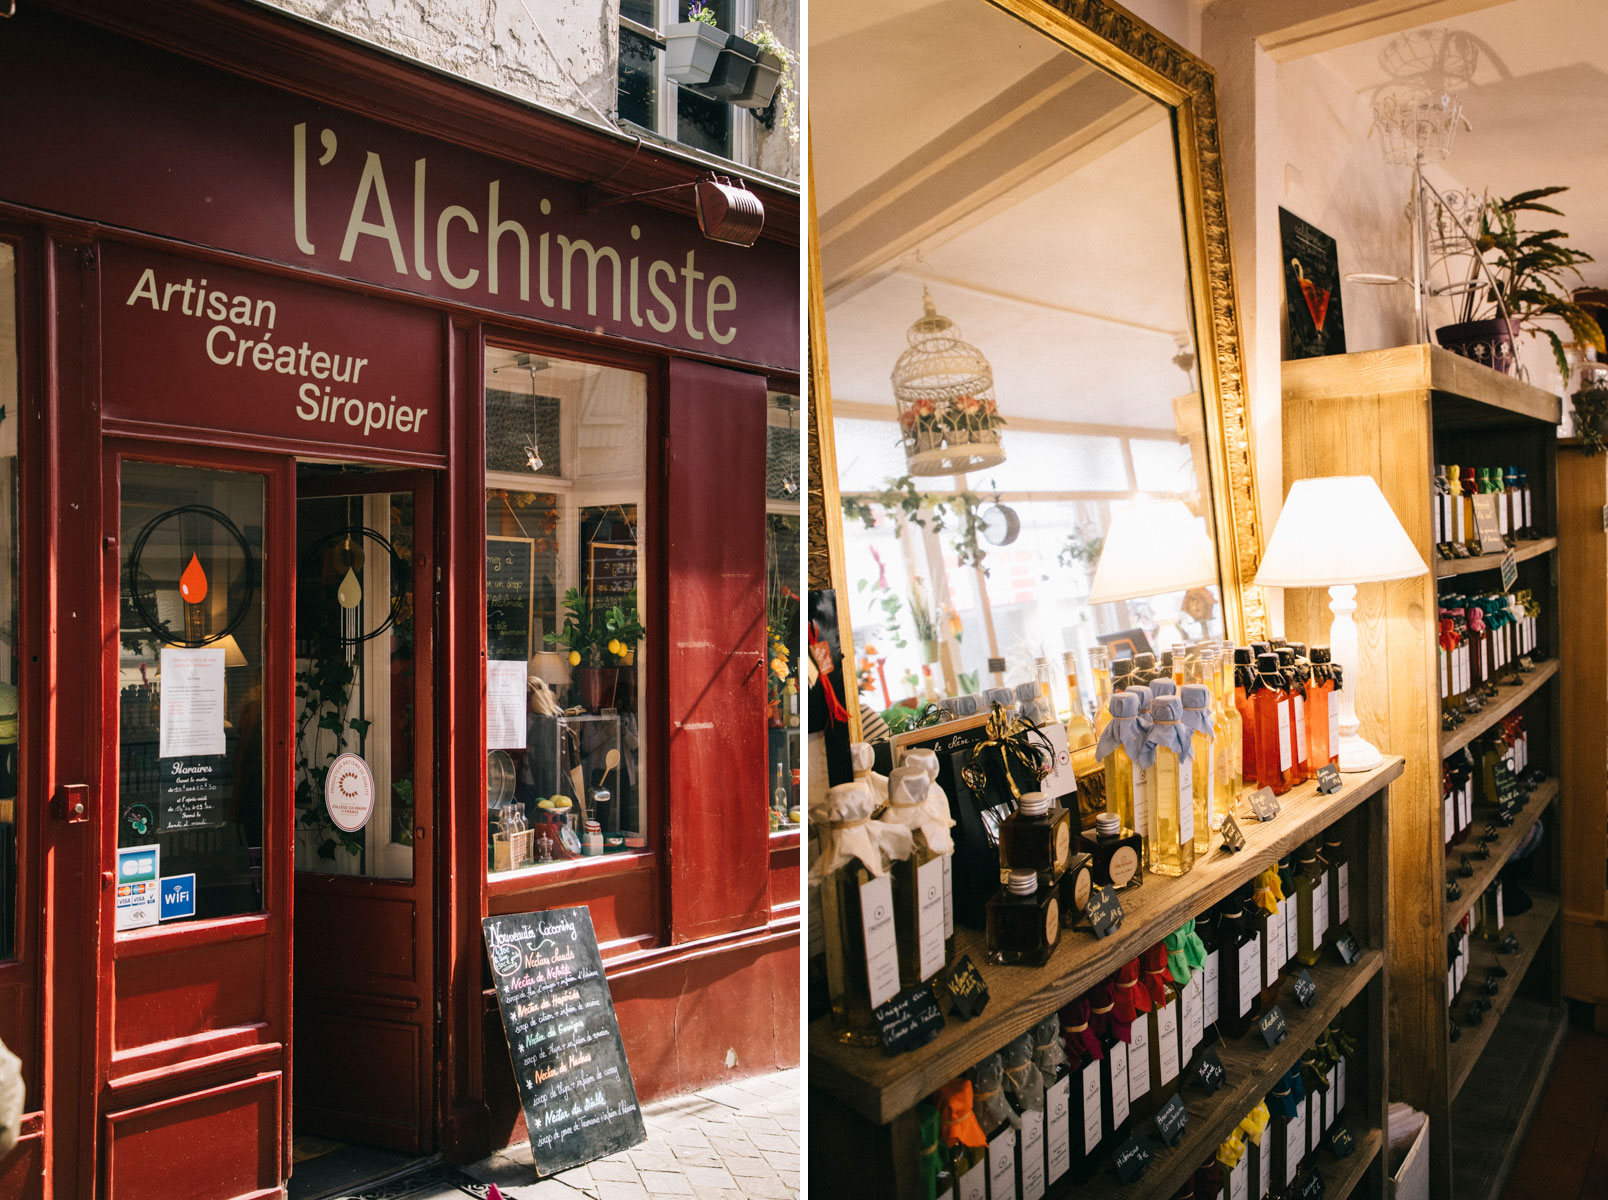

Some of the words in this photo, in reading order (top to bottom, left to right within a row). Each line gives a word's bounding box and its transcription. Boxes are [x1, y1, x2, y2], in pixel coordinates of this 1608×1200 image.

[293, 121, 738, 345] l'Alchimiste
[126, 267, 278, 329] Artisan
[205, 324, 369, 385] Créateur
[295, 382, 429, 436] Siropier
[171, 760, 213, 775] Horaires
[545, 1107, 570, 1127] Nectar
